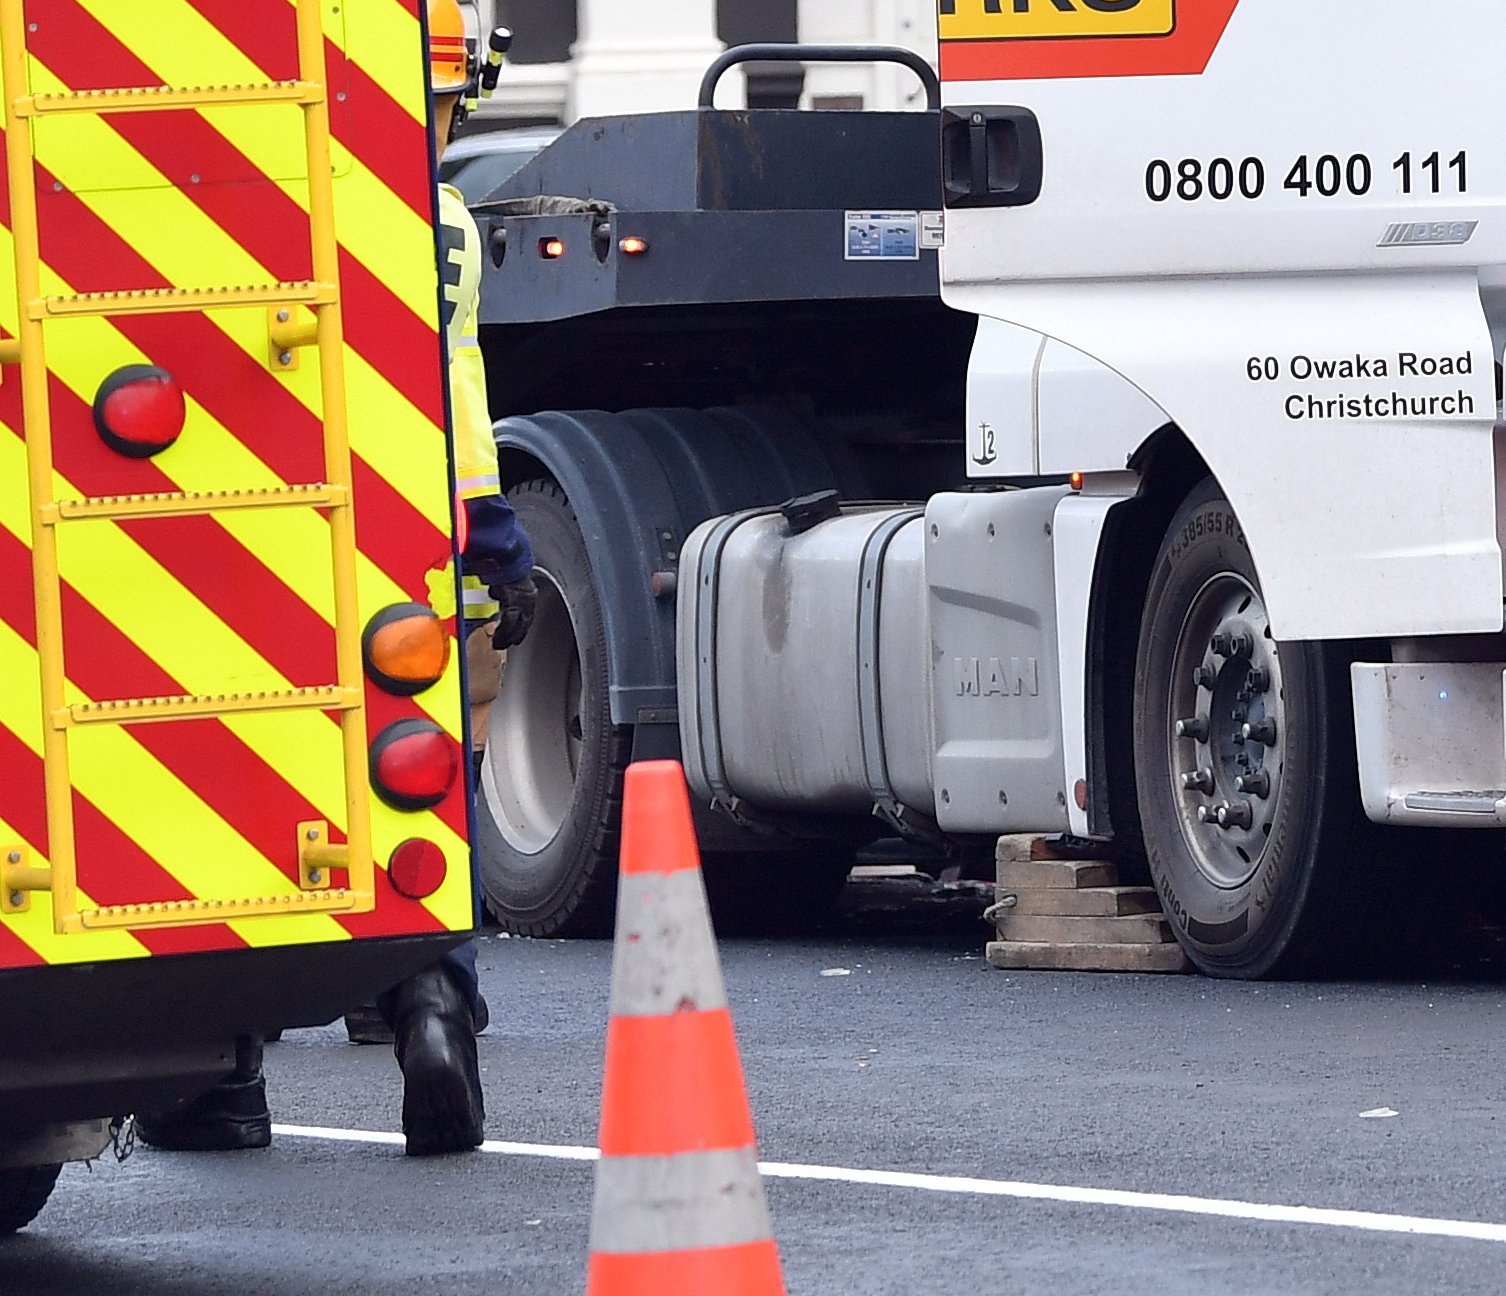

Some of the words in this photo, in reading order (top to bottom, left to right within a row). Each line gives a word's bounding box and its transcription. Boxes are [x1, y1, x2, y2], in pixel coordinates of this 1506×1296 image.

[1145, 157, 1264, 202] 0800
[1283, 154, 1371, 197] 400
[1392, 151, 1466, 193] 111
[1246, 357, 1279, 381] 60
[1290, 354, 1388, 379] Owaka
[1399, 350, 1472, 376] Road
[1285, 390, 1474, 419] Christchurch
[955, 657, 1039, 697] MAN
